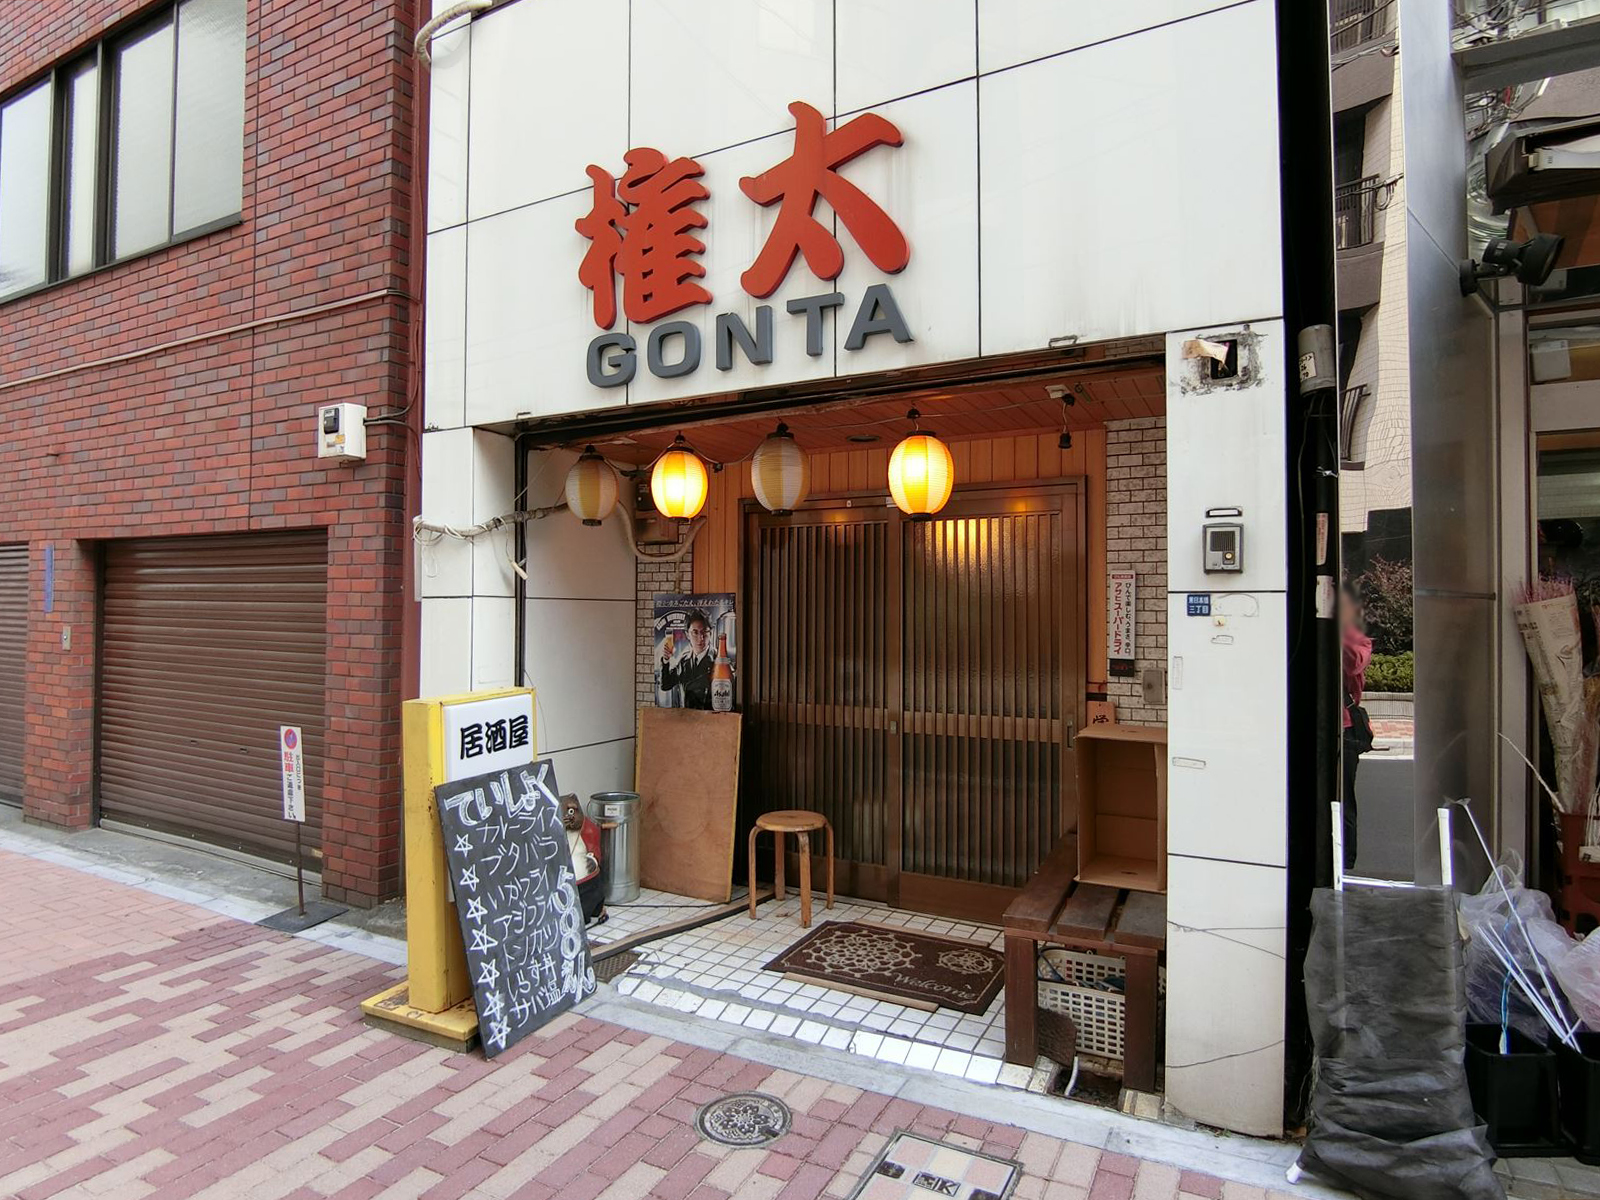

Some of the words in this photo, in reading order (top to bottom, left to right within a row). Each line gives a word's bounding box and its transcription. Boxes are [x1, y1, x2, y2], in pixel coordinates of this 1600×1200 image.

[575, 100, 911, 330] 権太
[586, 283, 914, 388] GONTA
[1113, 582, 1124, 655] アサヒスーパードライ
[1188, 605, 1209, 614] 三丁目
[460, 714, 529, 760] 居酒屋
[444, 764, 560, 826] ていしょく
[476, 806, 564, 844] カレーライス
[480, 833, 559, 876] ブタバラ
[487, 864, 550, 910] いかフライ
[503, 918, 559, 972] トンカツ
[509, 979, 566, 1028] サバ塩
[893, 972, 976, 999] Welcome
